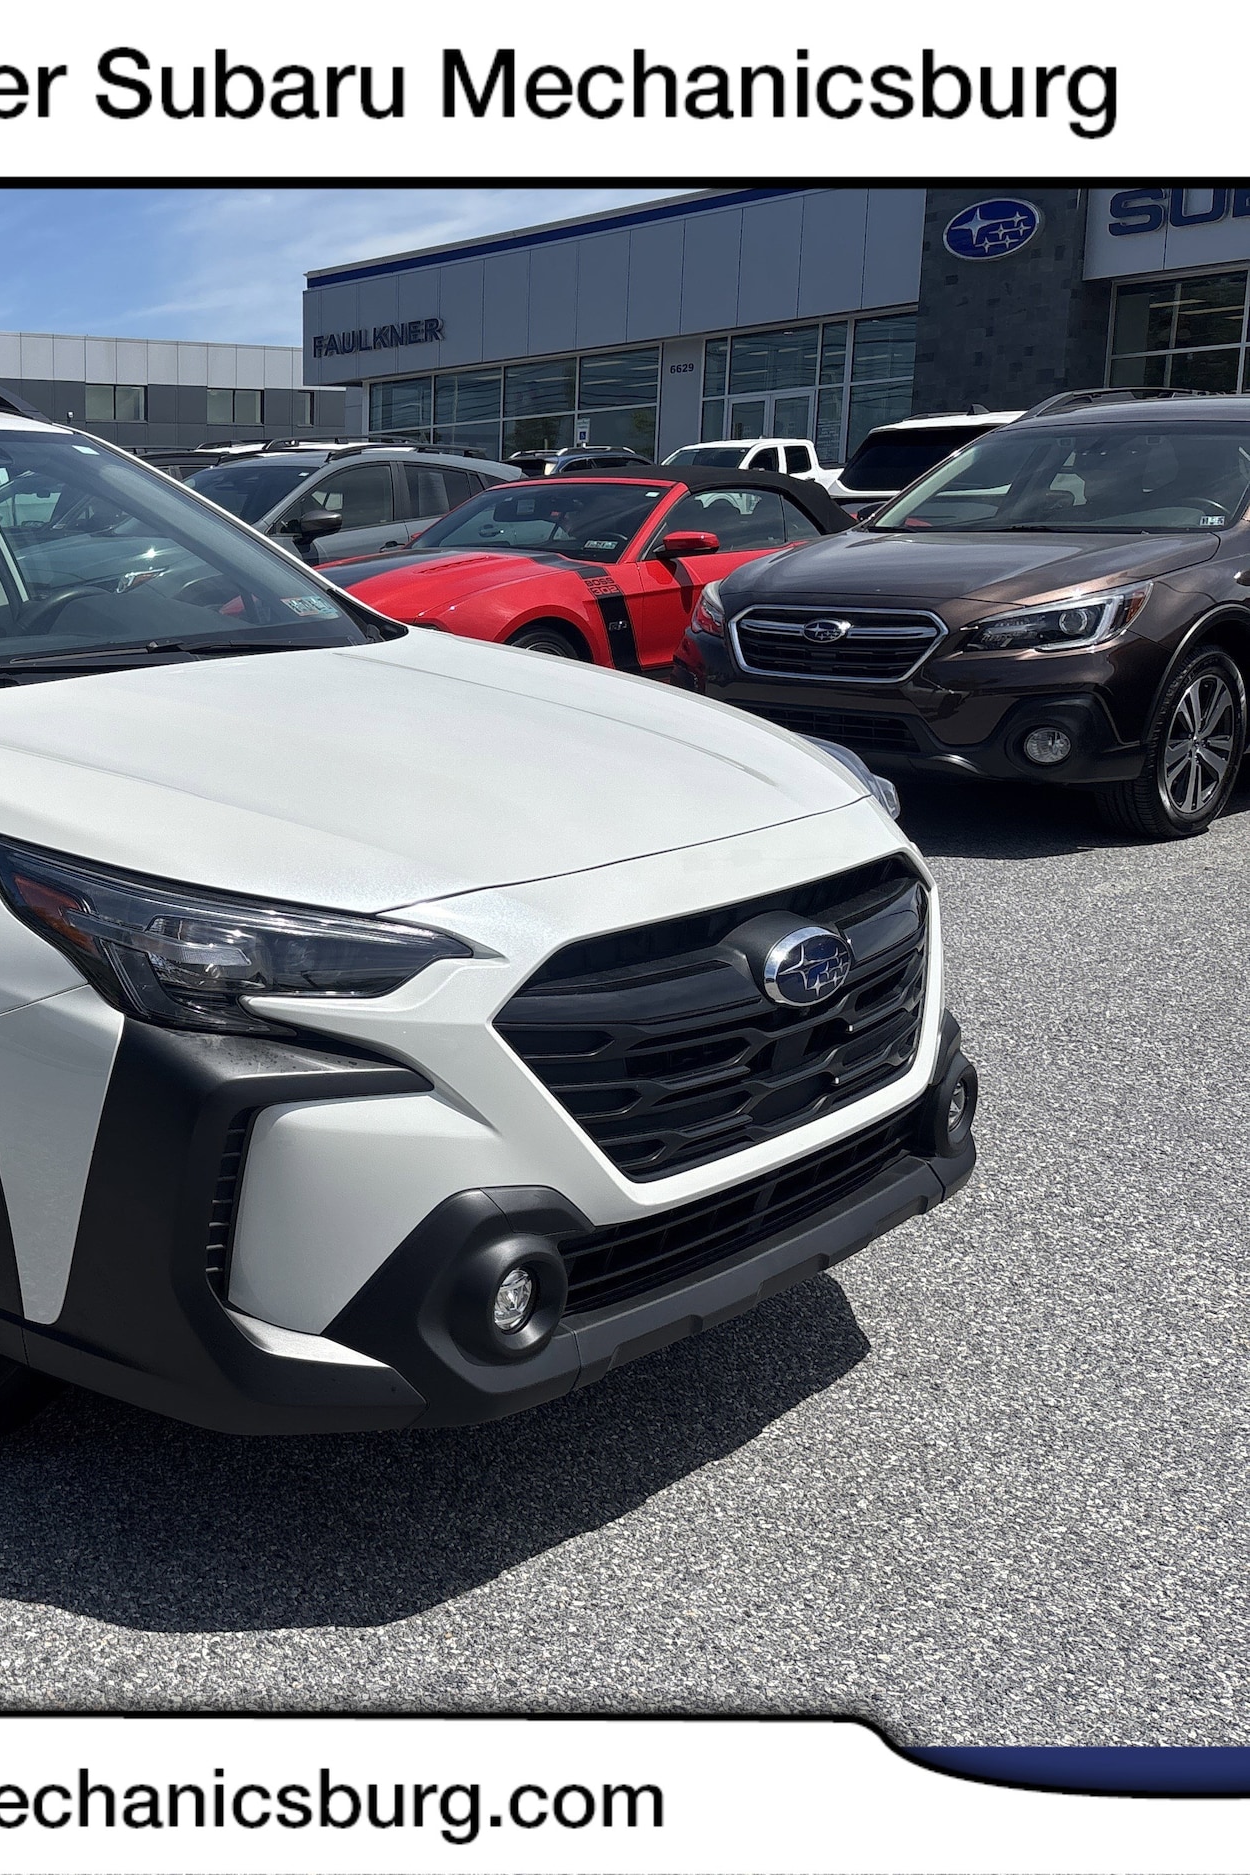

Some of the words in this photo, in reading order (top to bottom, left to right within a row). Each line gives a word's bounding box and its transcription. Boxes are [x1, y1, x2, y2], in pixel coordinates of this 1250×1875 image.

[313, 318, 444, 358] FAULKNER
[670, 363, 694, 374] 6629
[591, 585, 620, 596] 302
